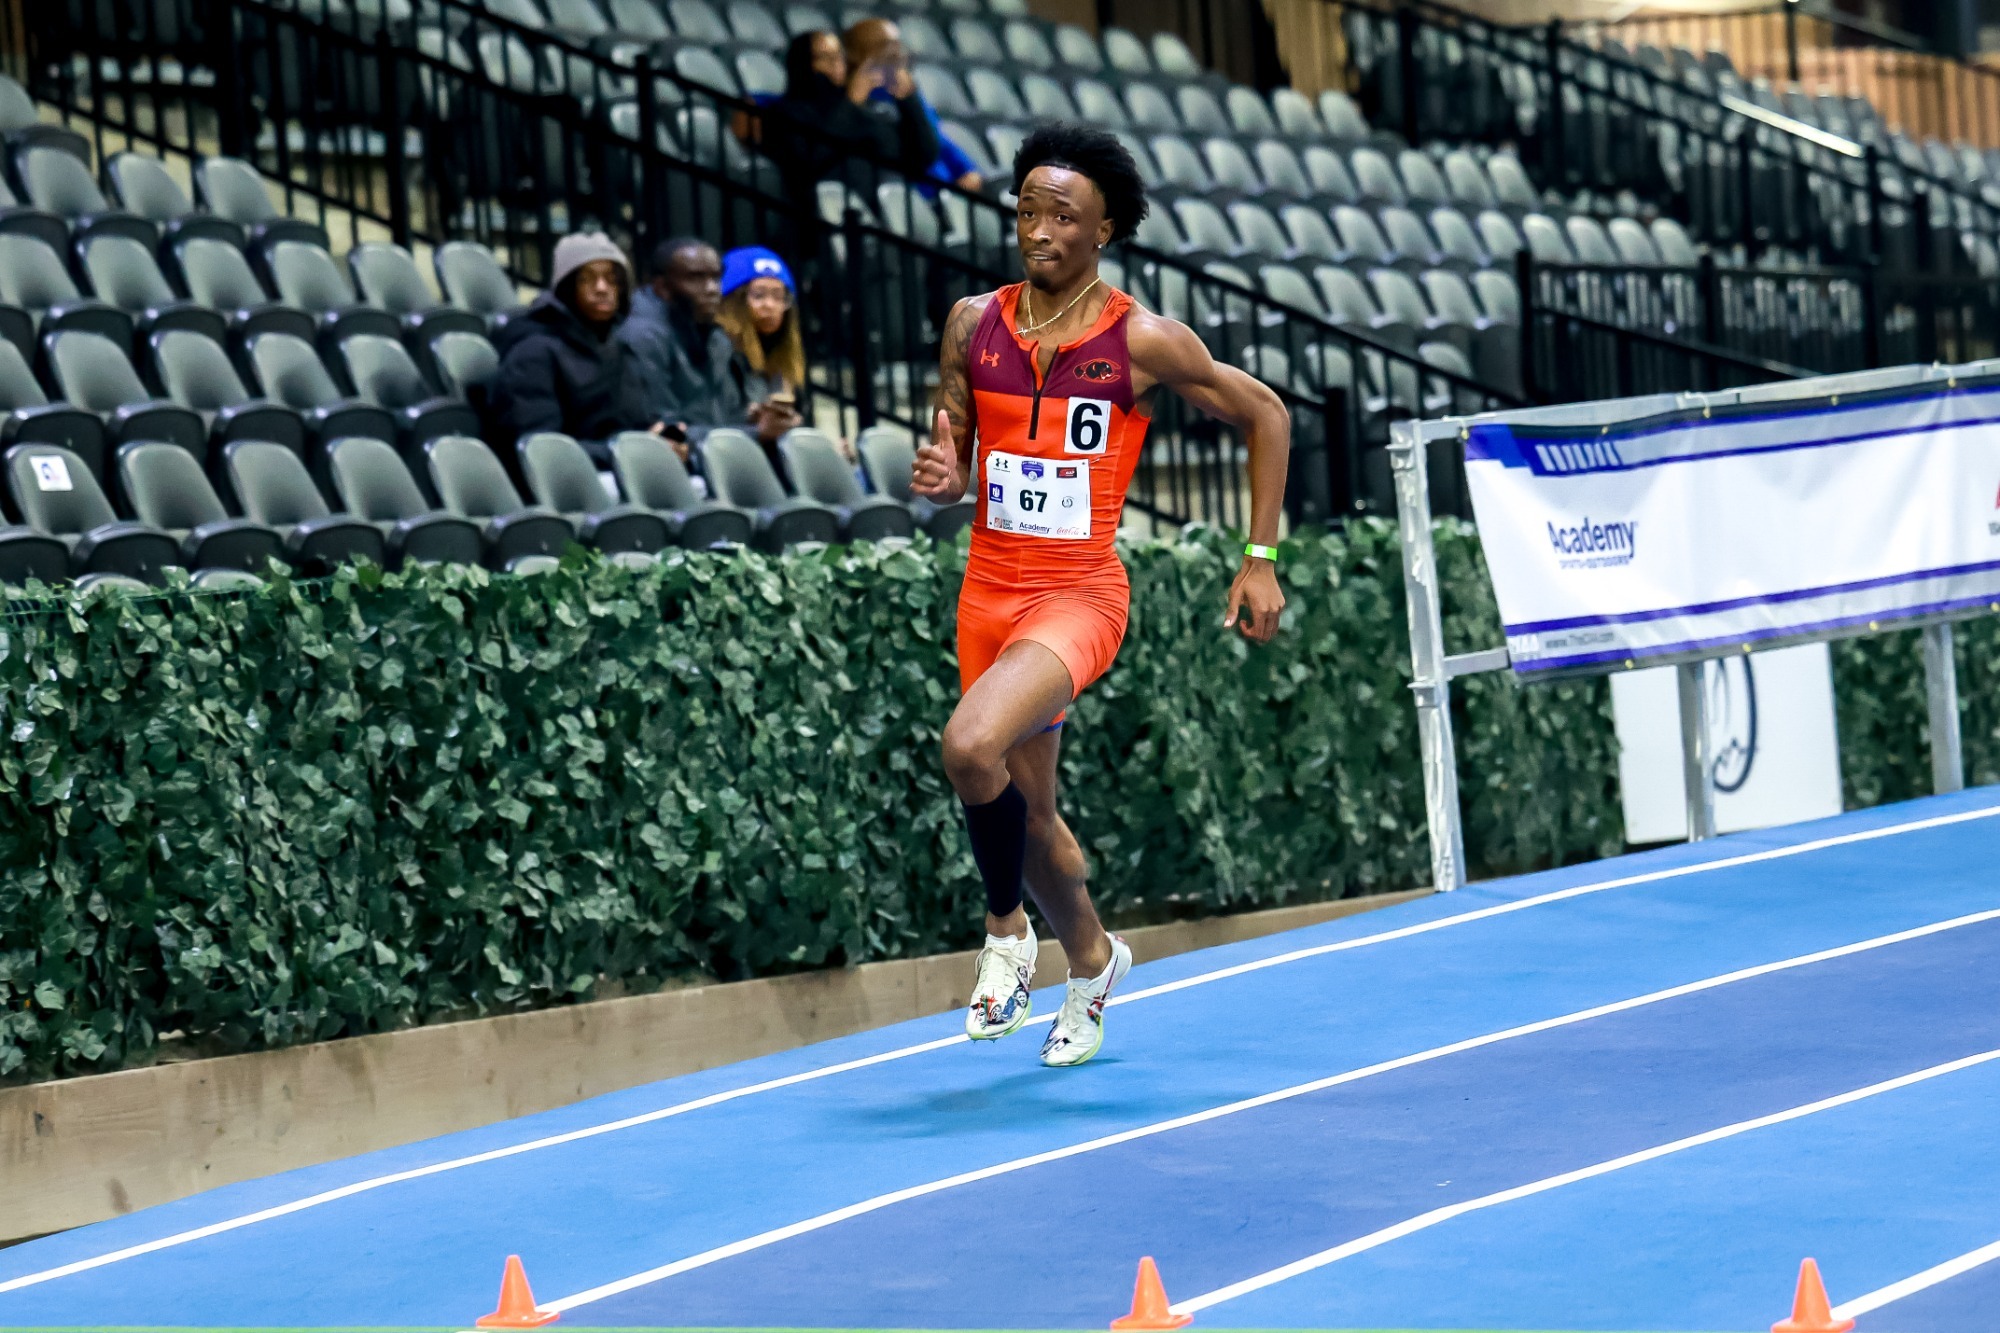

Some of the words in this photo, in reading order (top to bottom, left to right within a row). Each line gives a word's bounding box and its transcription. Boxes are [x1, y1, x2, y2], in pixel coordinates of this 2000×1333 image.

[1071, 402, 1103, 451] 6
[1019, 489, 1048, 513] 67
[1018, 522, 1052, 534] Academy
[1547, 516, 1635, 559] Academy
